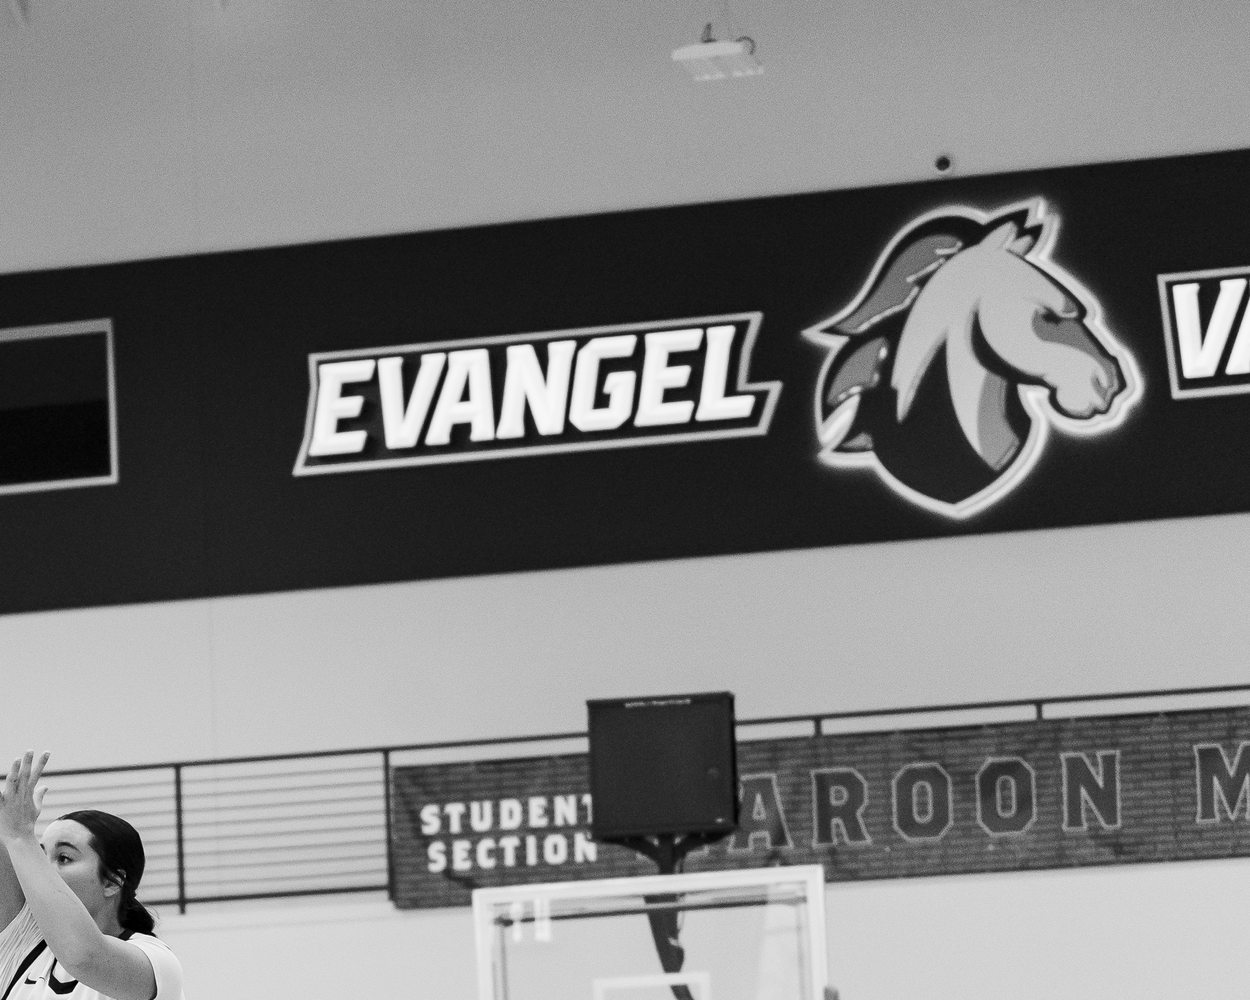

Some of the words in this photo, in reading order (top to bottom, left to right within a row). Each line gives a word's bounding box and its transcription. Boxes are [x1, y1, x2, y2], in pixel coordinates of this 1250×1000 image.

[1172, 277, 1250, 379] V
[309, 324, 755, 457] EVANGEL
[427, 832, 598, 873] SECTION
[728, 749, 1122, 853] AROON
